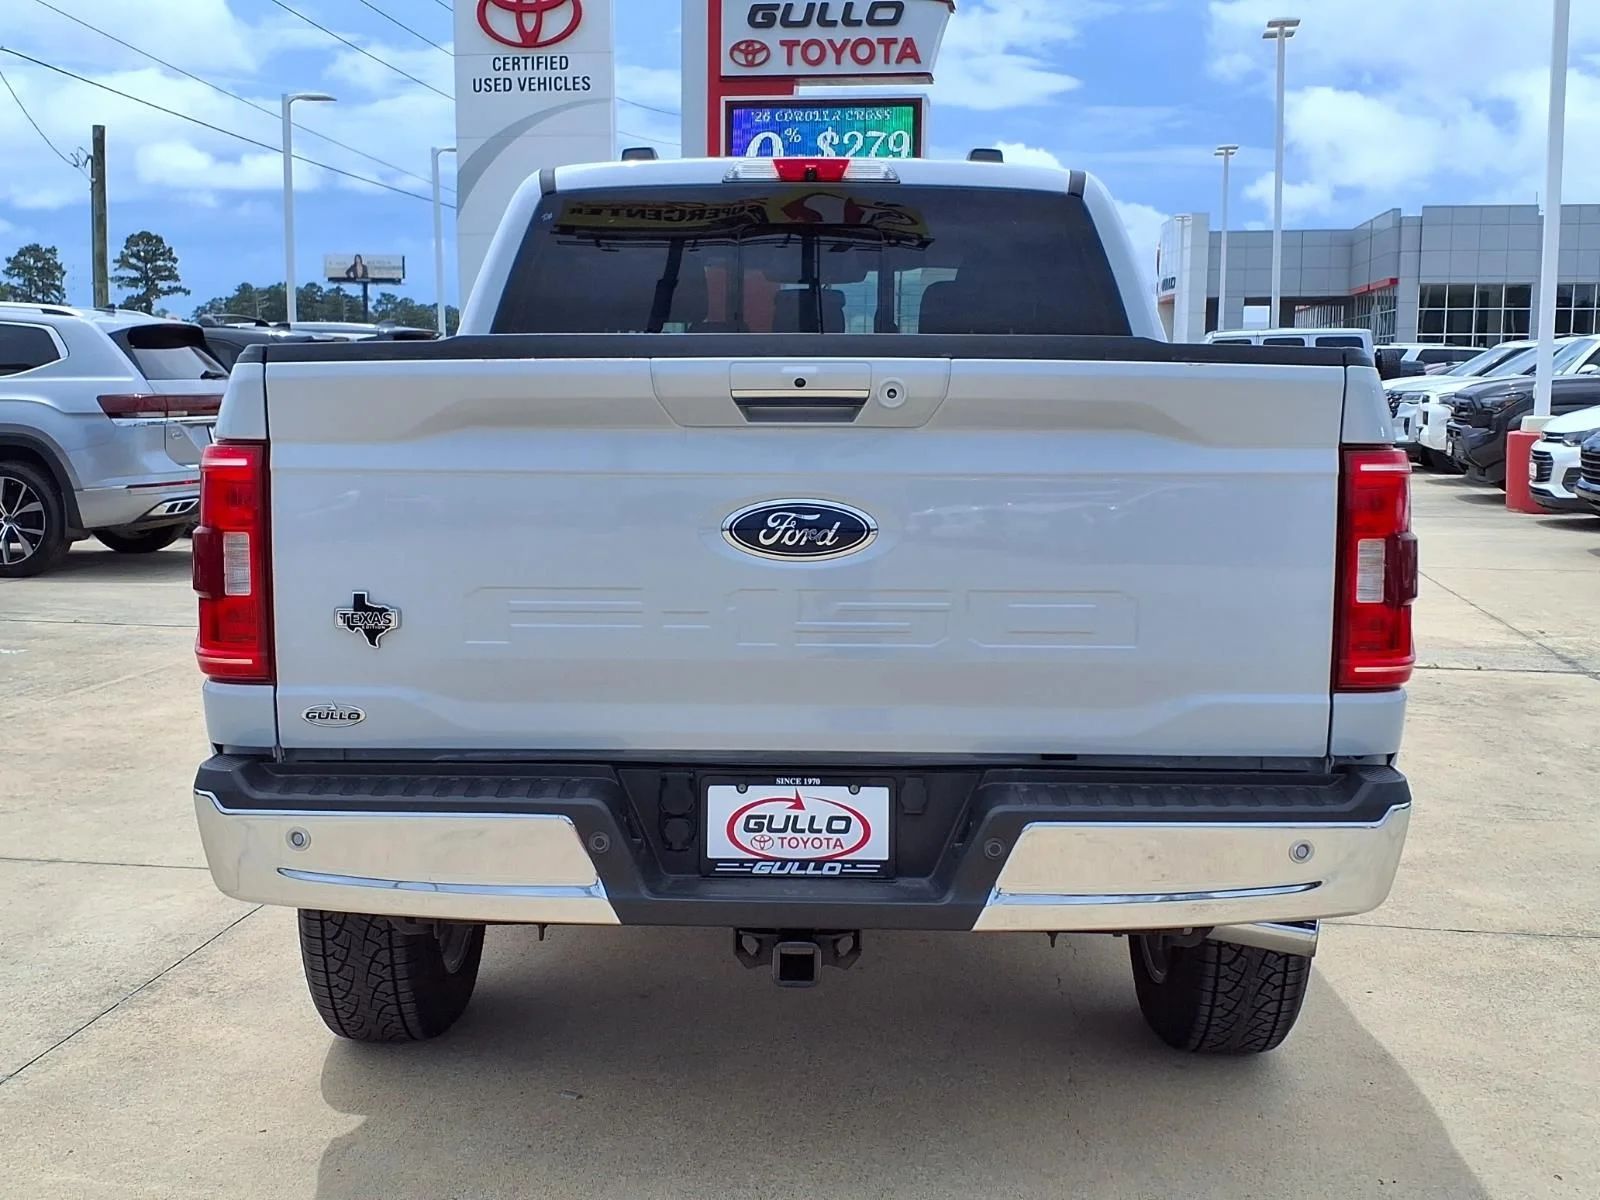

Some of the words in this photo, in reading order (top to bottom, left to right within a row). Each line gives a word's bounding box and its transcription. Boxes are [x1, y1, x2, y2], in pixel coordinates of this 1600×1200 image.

[747, 1, 904, 29] GULLO
[779, 37, 922, 67] TOYOTA
[492, 55, 569, 72] CERTIFIED
[472, 77, 513, 93] USED
[517, 75, 592, 92] VEHICLES
[775, 109, 841, 122] COROLLA
[845, 108, 893, 121] CROSS
[758, 511, 840, 546] Ford
[339, 611, 393, 625] TEXAS
[305, 711, 361, 720] GULLO
[775, 777, 802, 785] SINCE
[743, 814, 852, 834] GULLO
[777, 836, 844, 850] TOYOTA
[751, 861, 842, 875] GULLO
